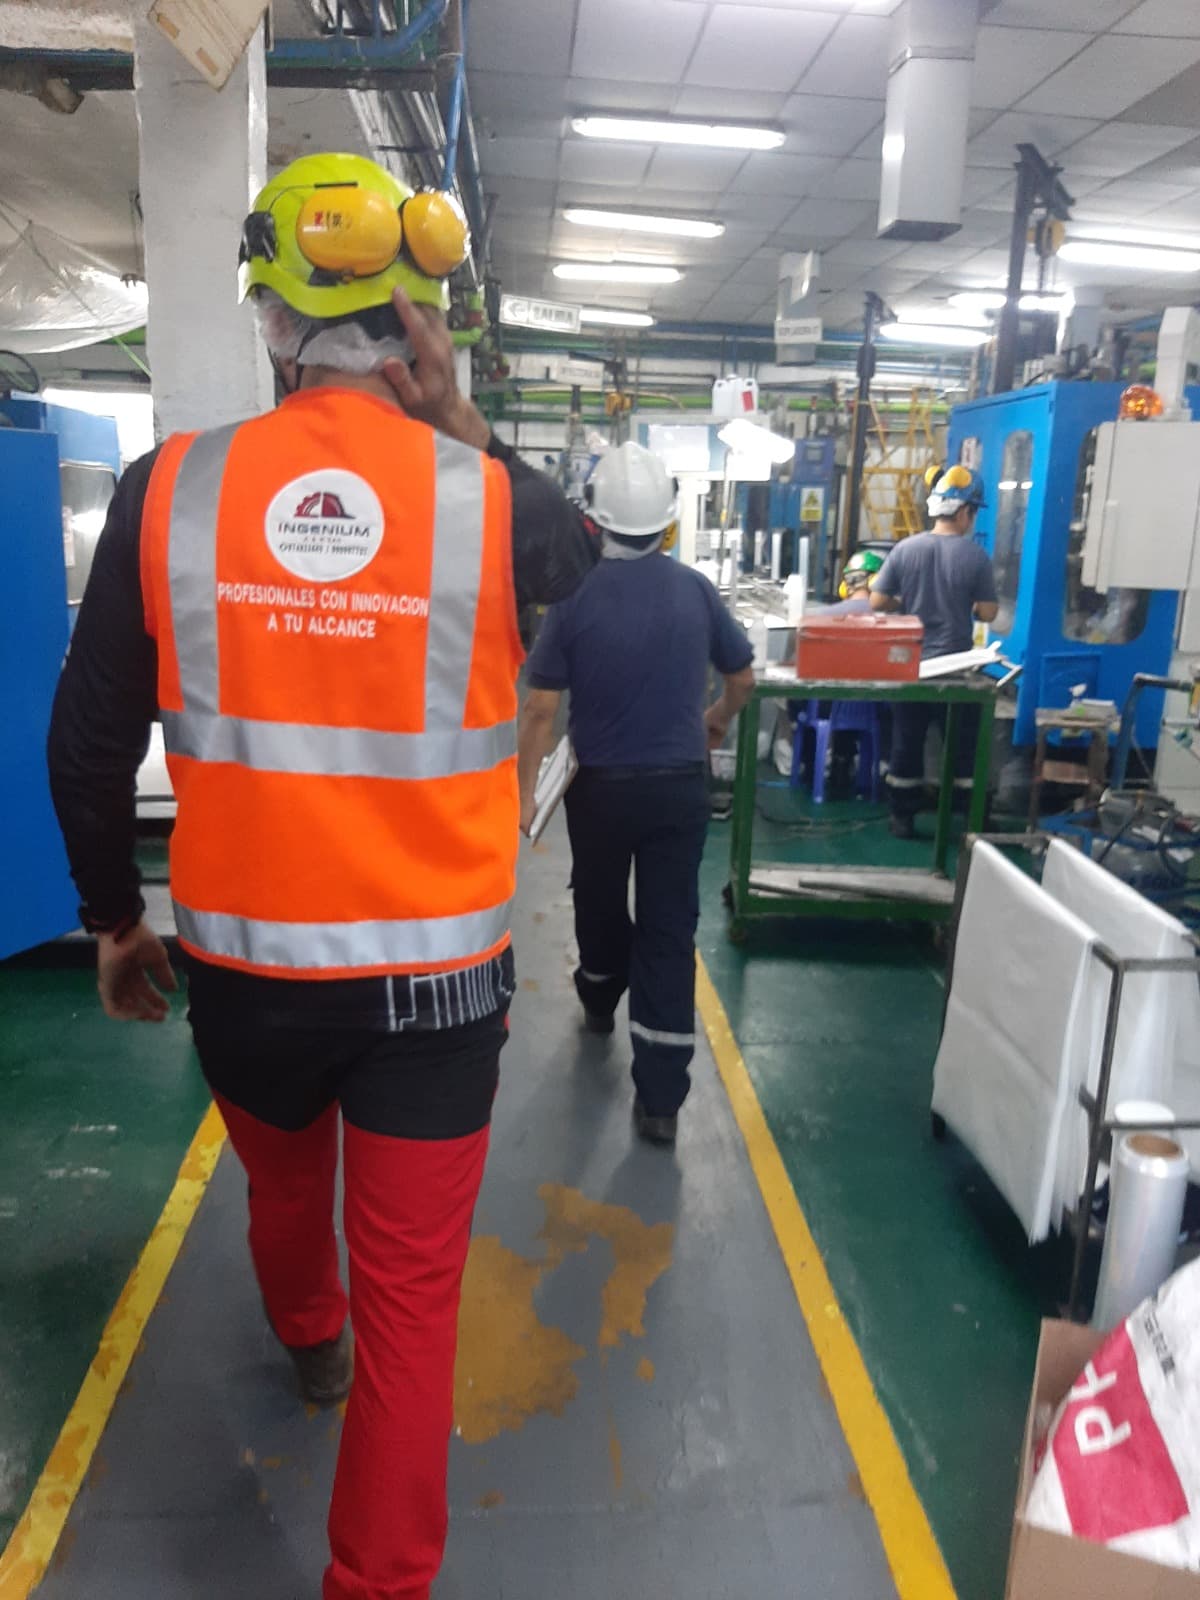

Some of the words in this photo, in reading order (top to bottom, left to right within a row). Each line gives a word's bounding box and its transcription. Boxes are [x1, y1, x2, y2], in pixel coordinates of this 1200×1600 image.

[217, 583, 315, 608] PROFESIONALES
[321, 589, 348, 610] CON
[351, 592, 429, 617] INNOVACION
[267, 612, 278, 632] A
[284, 613, 303, 632] TU
[308, 615, 376, 638] ALCANCE
